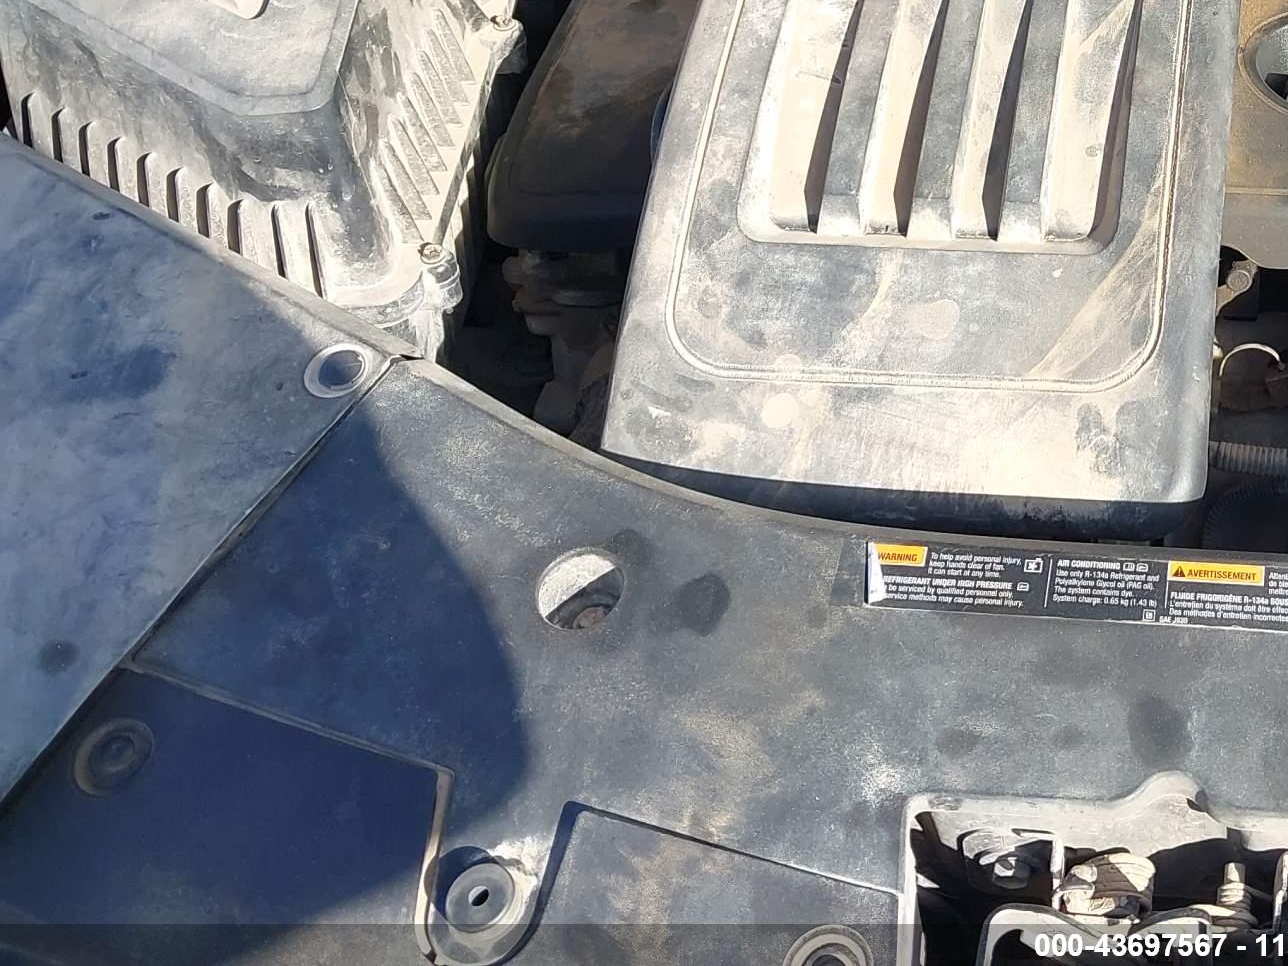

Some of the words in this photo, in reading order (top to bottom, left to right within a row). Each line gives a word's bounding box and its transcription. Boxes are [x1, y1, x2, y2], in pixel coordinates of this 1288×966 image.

[878, 552, 918, 562] WARNING
[931, 552, 938, 560] To
[1057, 559, 1070, 567] AIR
[1071, 560, 1121, 570] CONDITIONING
[1084, 570, 1109, 579] R-134a
[1110, 571, 1146, 581] Refrigerant
[1187, 569, 1256, 581] AVERTISSEMENT
[883, 575, 931, 585] REFRIGERANT
[932, 578, 956, 587] UNDER
[957, 579, 975, 587] HIGH
[976, 580, 1013, 590] PRESSURE
[1103, 596, 1119, 605] 0.65
[1170, 591, 1195, 600] FLUIDE
[1243, 595, 1269, 605] R-134a
[1159, 615, 1172, 624] SAE
